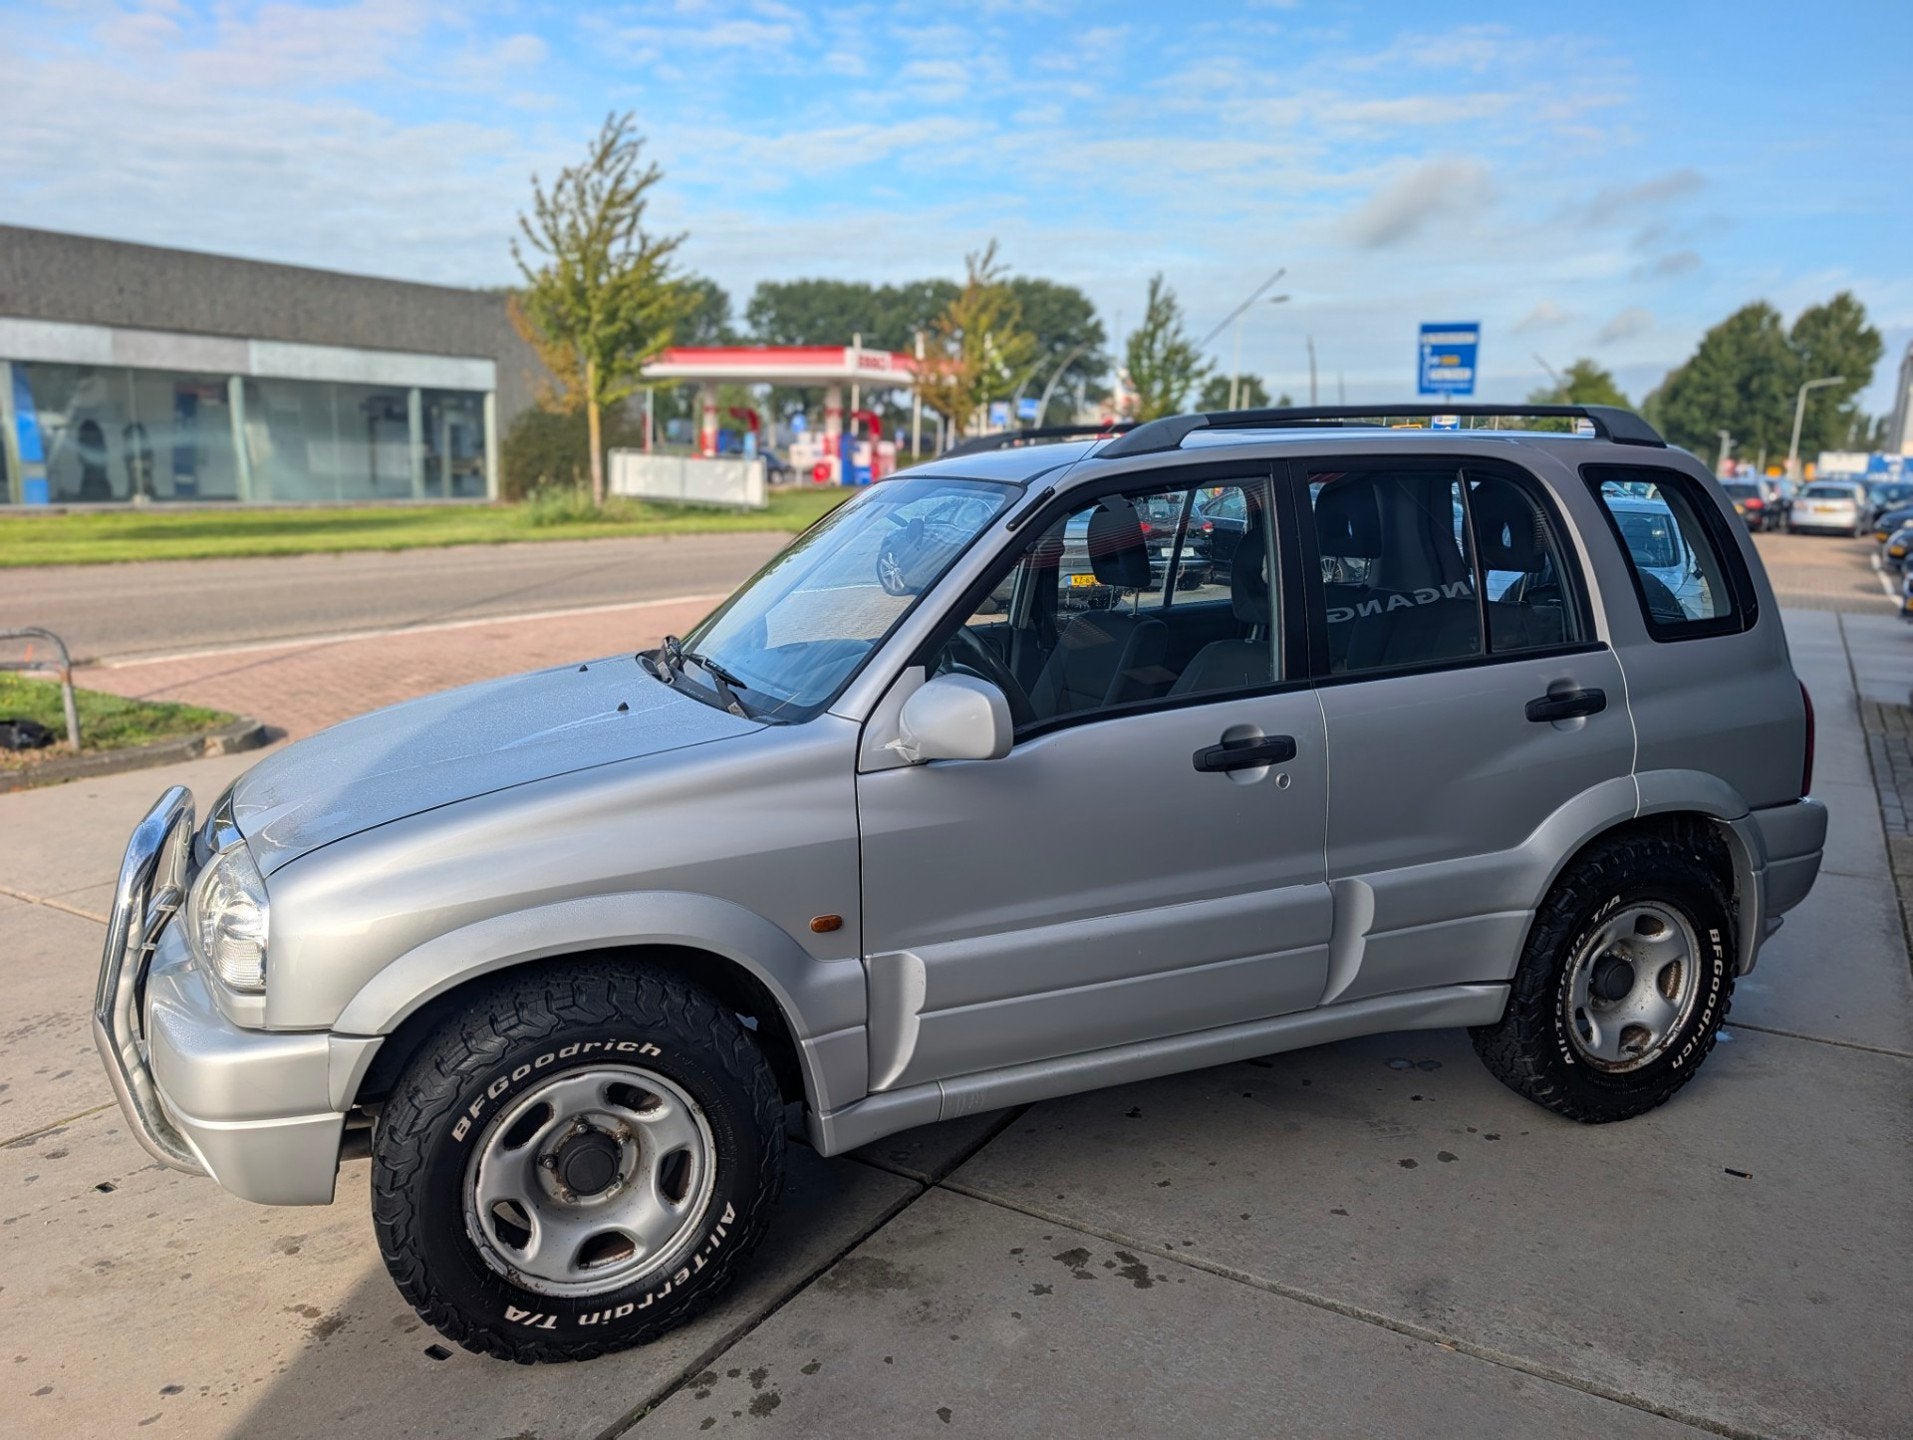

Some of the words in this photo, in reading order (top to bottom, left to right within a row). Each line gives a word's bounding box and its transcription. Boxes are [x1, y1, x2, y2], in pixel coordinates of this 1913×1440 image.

[1592, 895, 1621, 922] T/A
[1672, 929, 1723, 1069] BFGoodrich
[451, 1038, 662, 1142] BFGoodrich
[578, 1201, 736, 1326] All-Terrain
[504, 1305, 558, 1329] T/A
